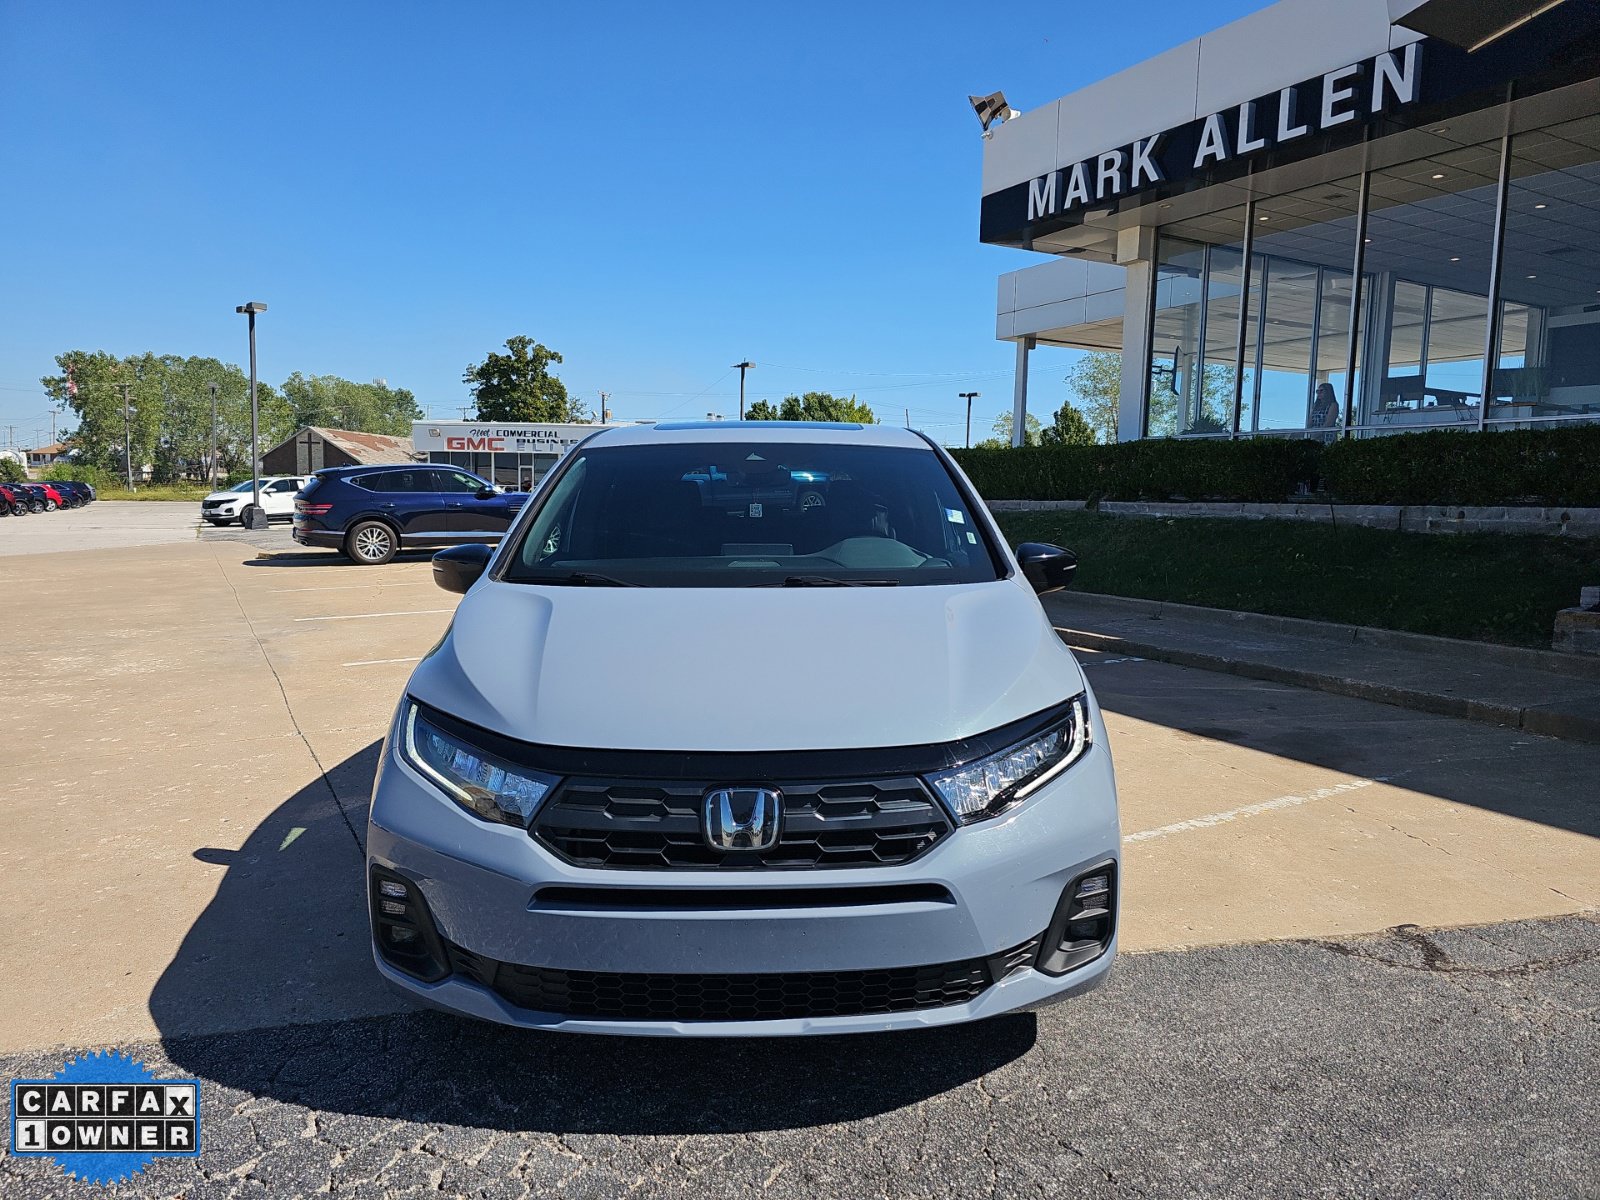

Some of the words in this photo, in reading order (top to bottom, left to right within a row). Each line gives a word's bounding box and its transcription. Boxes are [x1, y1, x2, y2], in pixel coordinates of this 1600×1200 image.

[1027, 133, 1163, 220] MARK
[1193, 42, 1424, 168] ALLEN
[470, 429, 490, 438] Fleet
[496, 430, 560, 438] COMMERCIAL
[447, 437, 505, 451] GMC
[516, 443, 571, 452] ELIT
